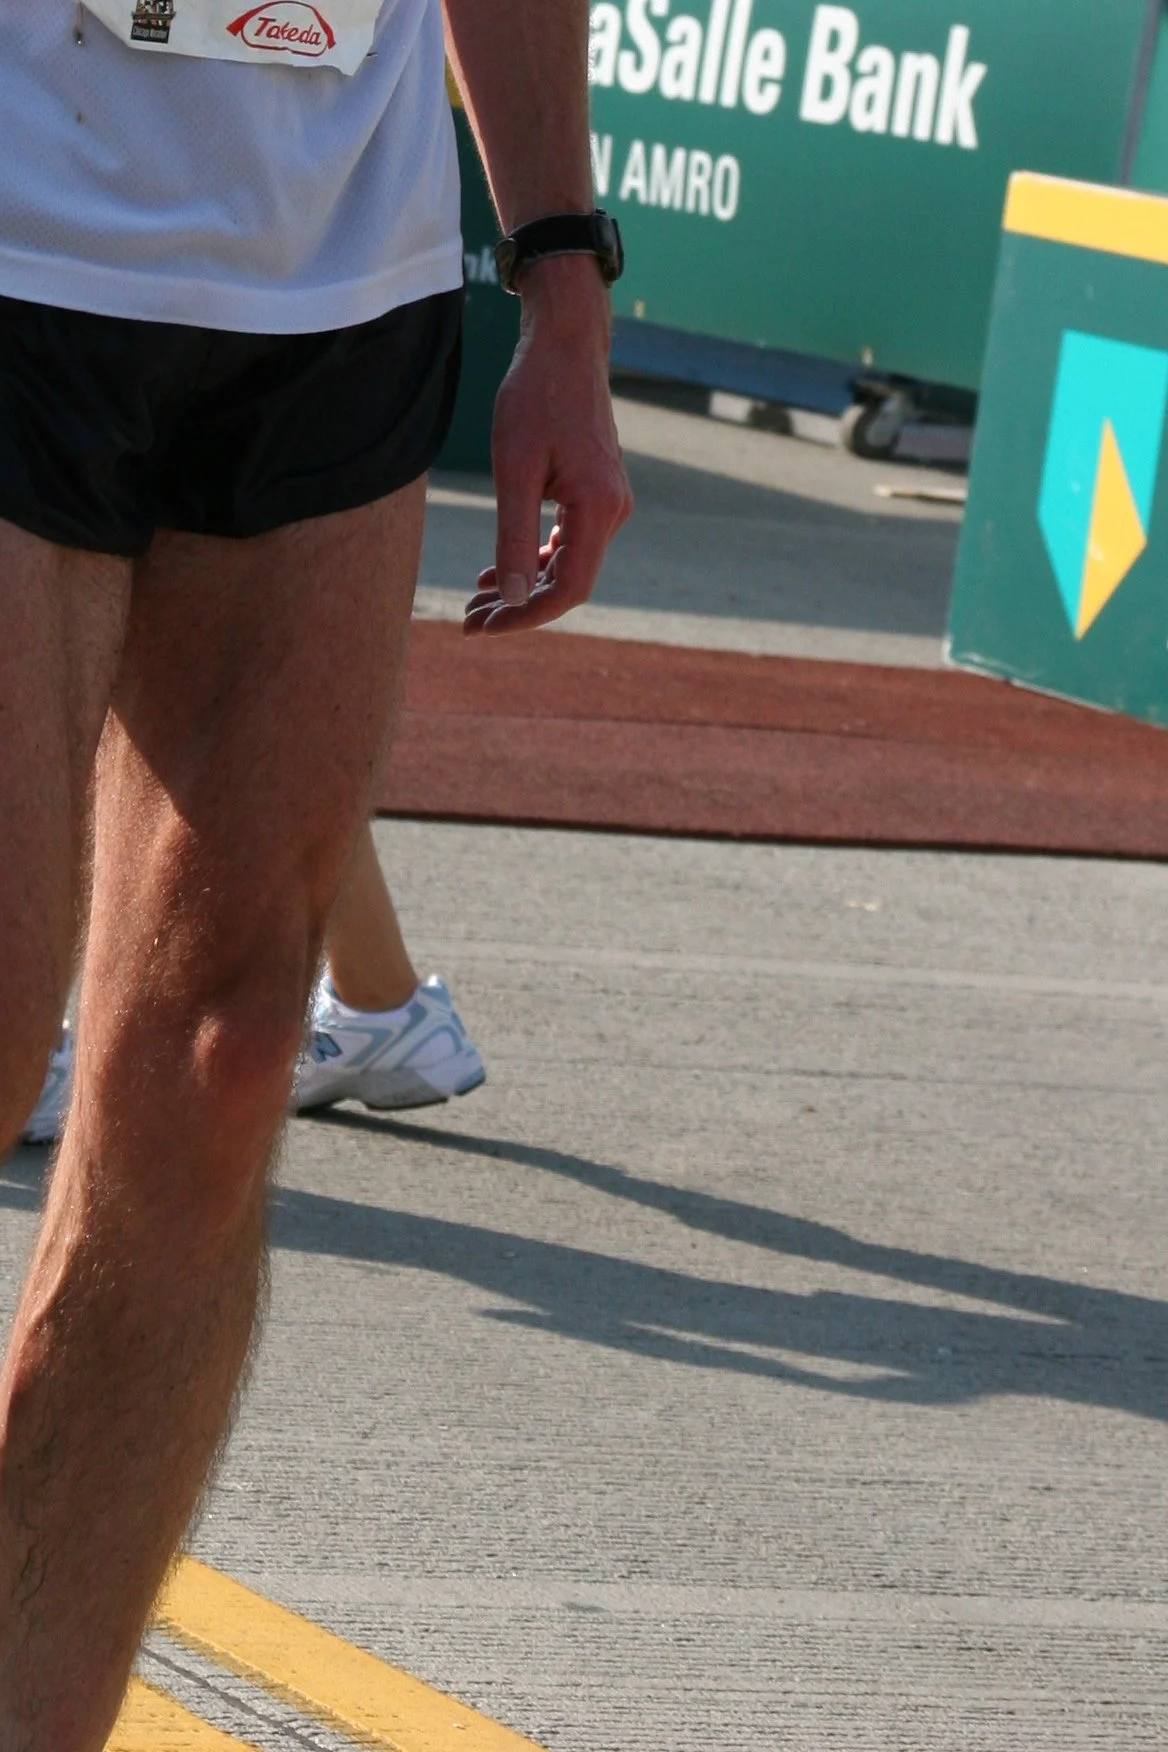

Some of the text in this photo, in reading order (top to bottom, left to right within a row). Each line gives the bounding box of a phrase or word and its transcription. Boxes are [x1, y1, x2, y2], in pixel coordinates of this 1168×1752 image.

[253, 16, 323, 47] Takeda
[799, 3, 989, 150] Bank
[620, 139, 742, 222] AMRO
